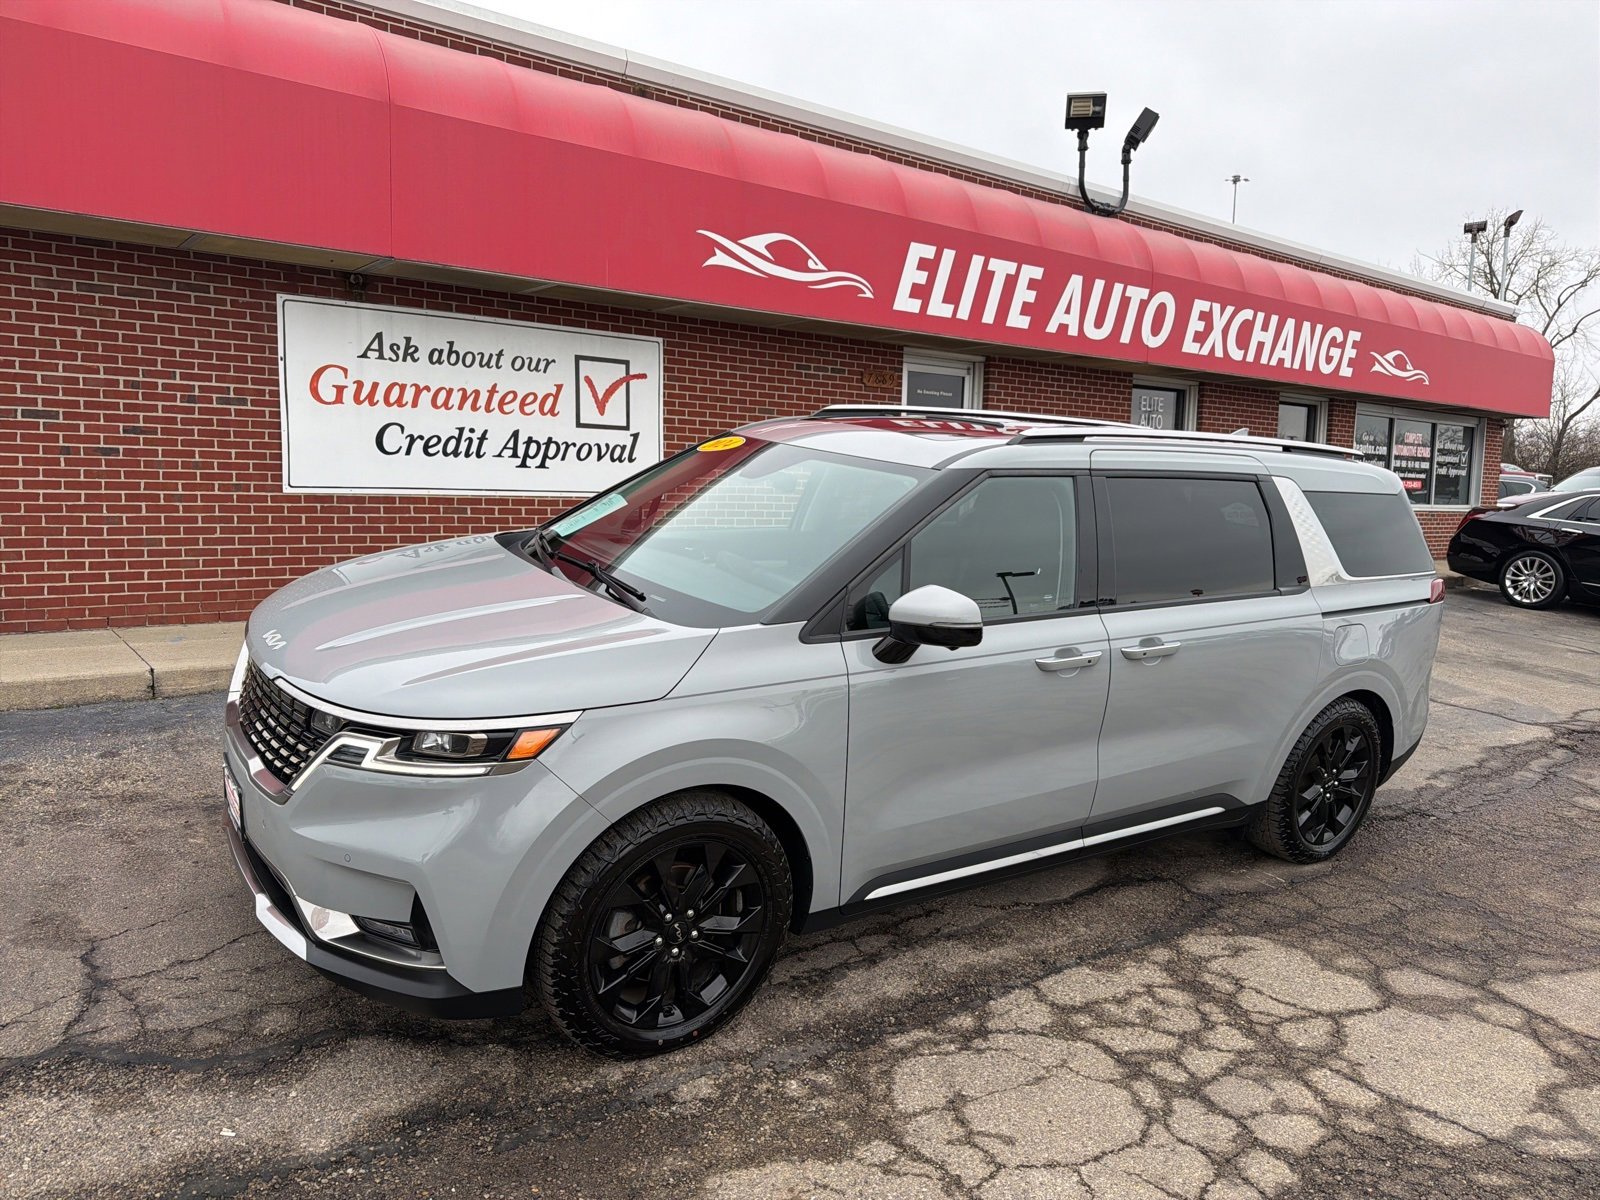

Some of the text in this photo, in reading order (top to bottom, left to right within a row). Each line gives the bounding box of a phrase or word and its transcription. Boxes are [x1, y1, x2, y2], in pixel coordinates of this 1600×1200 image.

[892, 241, 1362, 378] ELITE AUTO EXCHANGE
[357, 331, 557, 375] Ask about our
[309, 363, 564, 418] Guaranteed
[1140, 395, 1165, 412] ELITE
[1139, 413, 1163, 429] AUTO
[375, 421, 640, 470] Credit Approval
